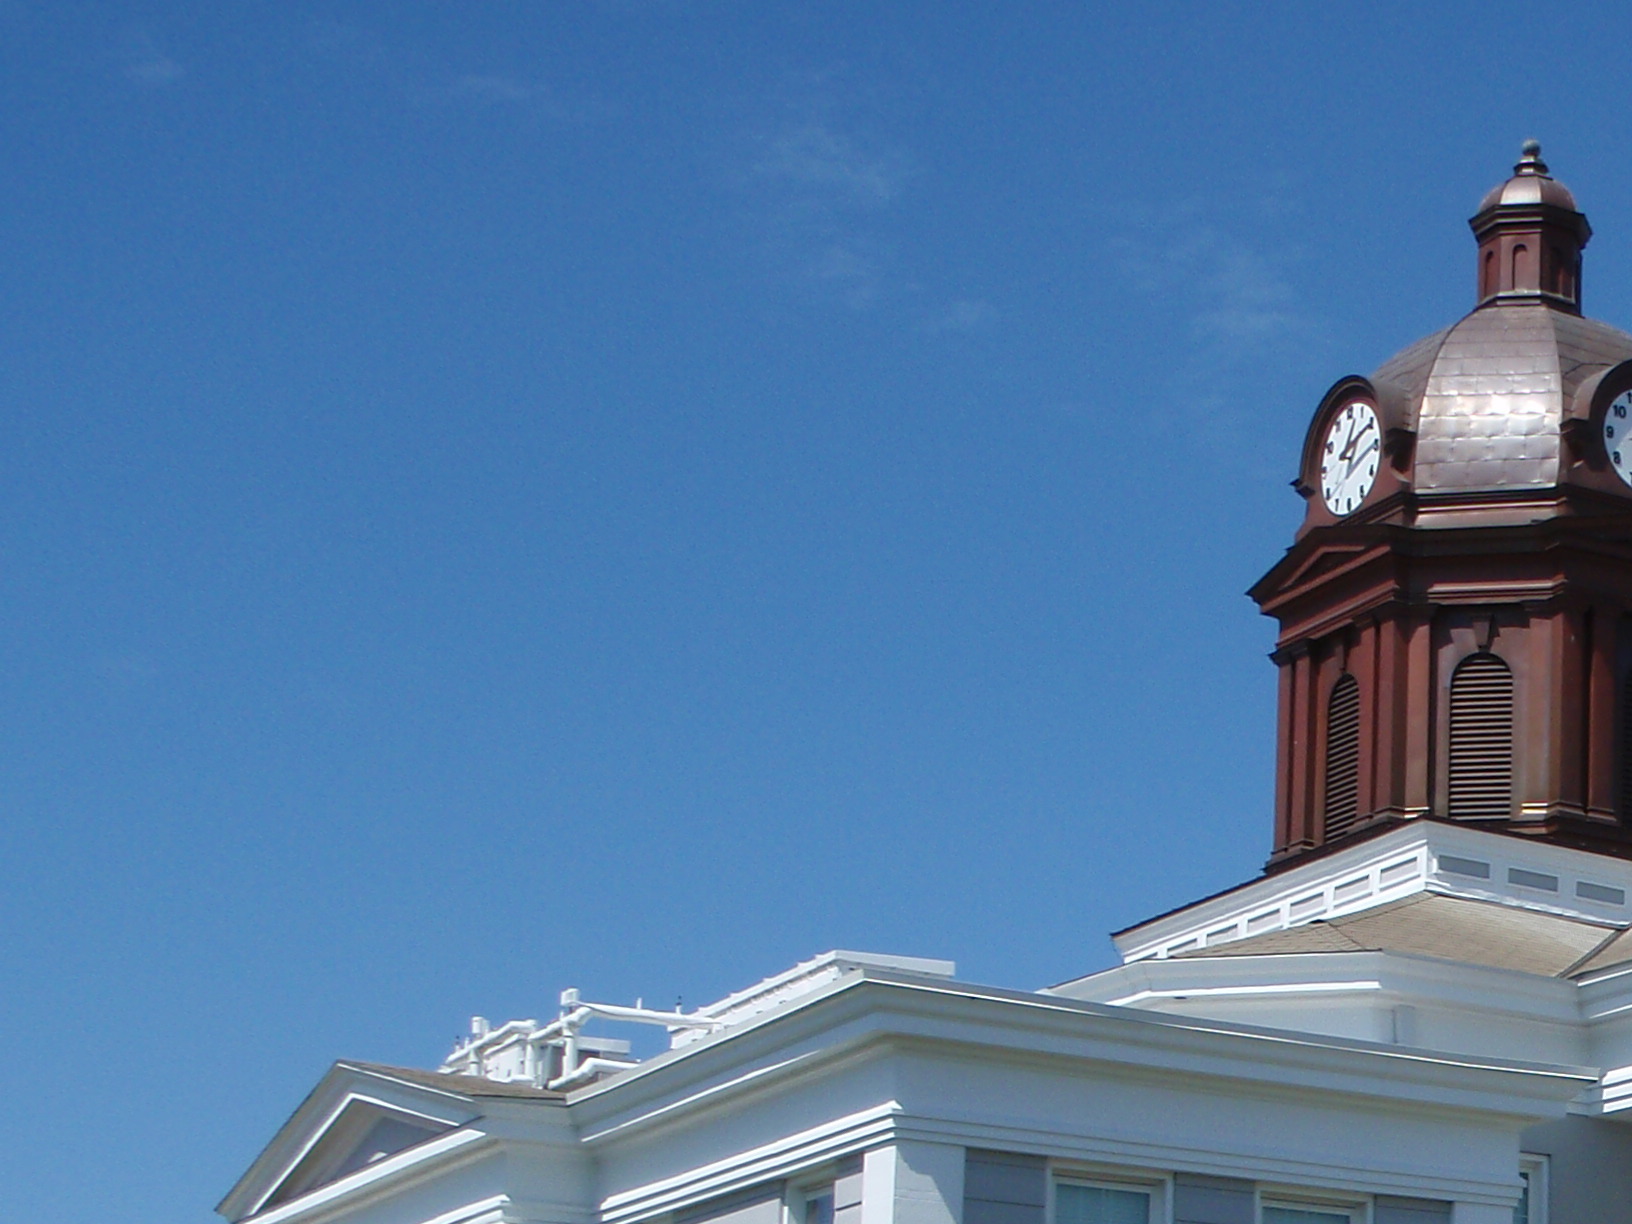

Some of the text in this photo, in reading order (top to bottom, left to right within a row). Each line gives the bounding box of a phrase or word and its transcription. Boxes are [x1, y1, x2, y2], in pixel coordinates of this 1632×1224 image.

[1613, 404, 1627, 419] 10
[1606, 425, 1614, 439] 9
[1613, 451, 1621, 464] 8
